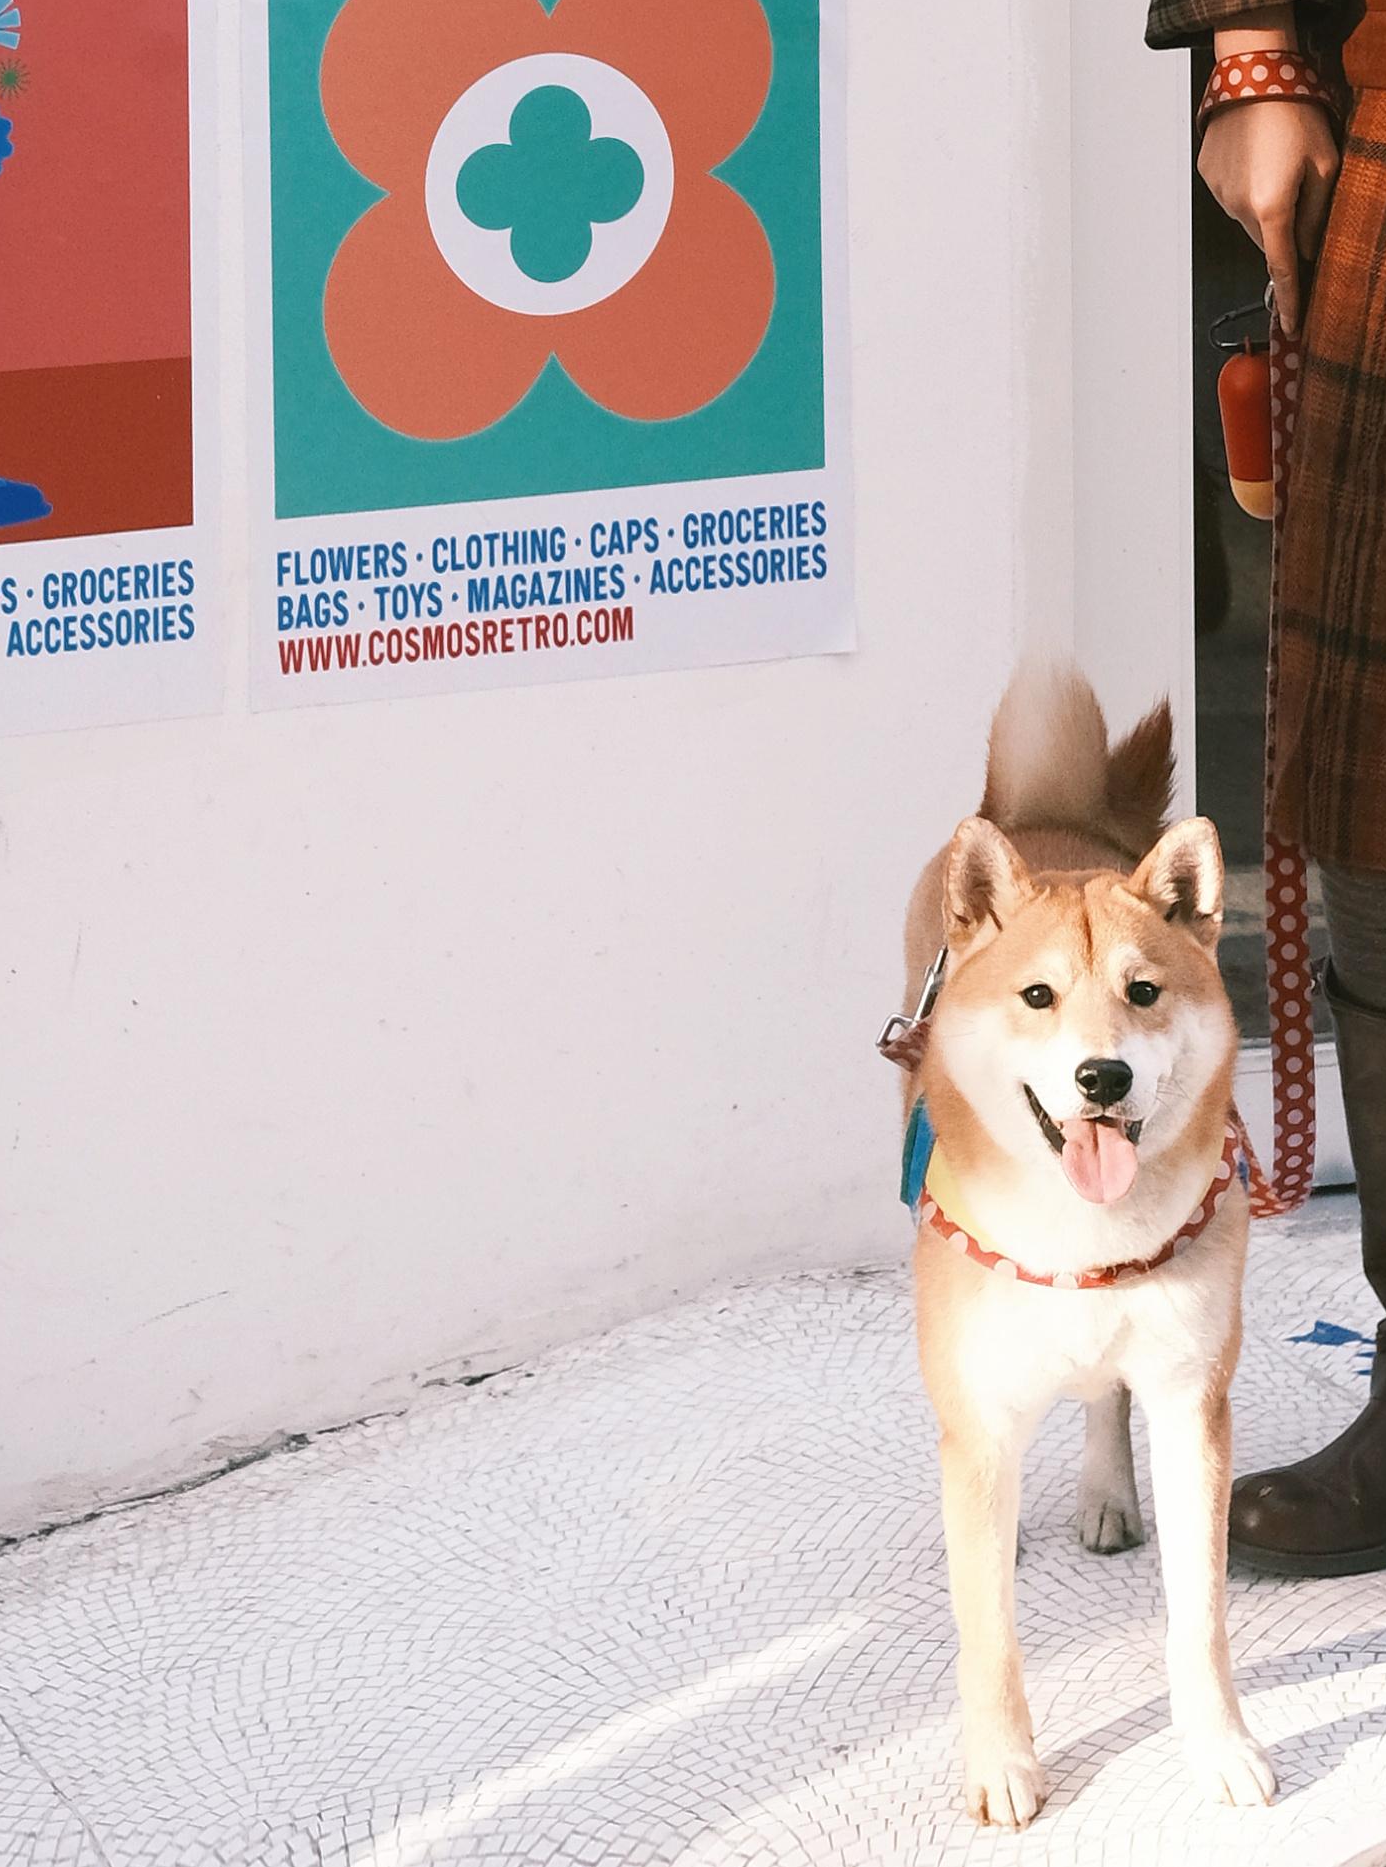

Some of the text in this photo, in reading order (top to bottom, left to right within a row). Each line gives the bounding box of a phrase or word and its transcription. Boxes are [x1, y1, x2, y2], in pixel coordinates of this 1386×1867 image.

[277, 501, 826, 586] FLOWERS CLOTHING CAPS GROCERIES
[43, 560, 194, 609] GROCERIES
[277, 543, 826, 632] BAGS TOYS MAGAZINES ACCESSORIES
[7, 603, 194, 656] ACCESSORIES
[278, 605, 633, 674] WWW.COSMOSRETRO.COM
